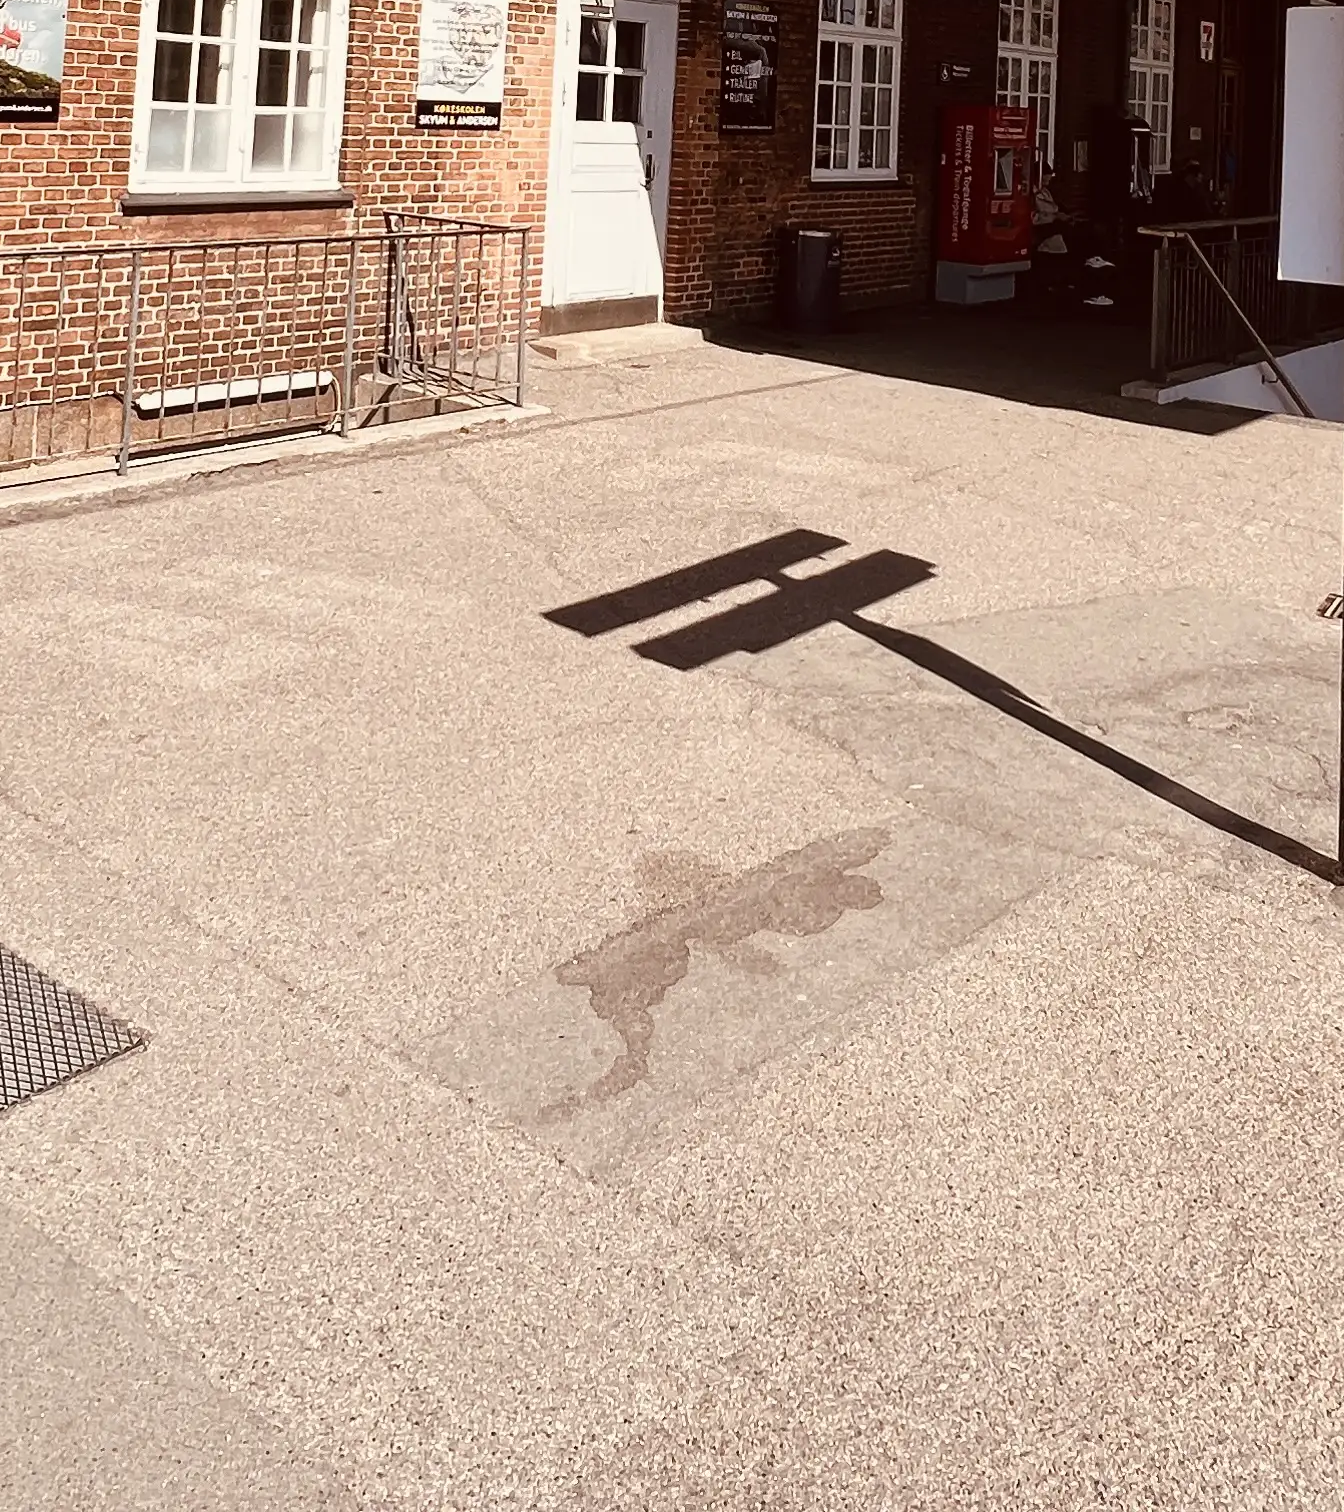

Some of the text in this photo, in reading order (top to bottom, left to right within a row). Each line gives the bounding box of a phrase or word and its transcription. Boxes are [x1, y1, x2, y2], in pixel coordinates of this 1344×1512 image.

[8, 16, 37, 32] bus
[731, 49, 743, 60] BIL
[418, 115, 499, 126] SKYUM & ANDERSEN
[955, 125, 965, 157] Tickets
[963, 124, 975, 164] Billetter
[954, 158, 963, 166] &
[963, 165, 973, 173] &
